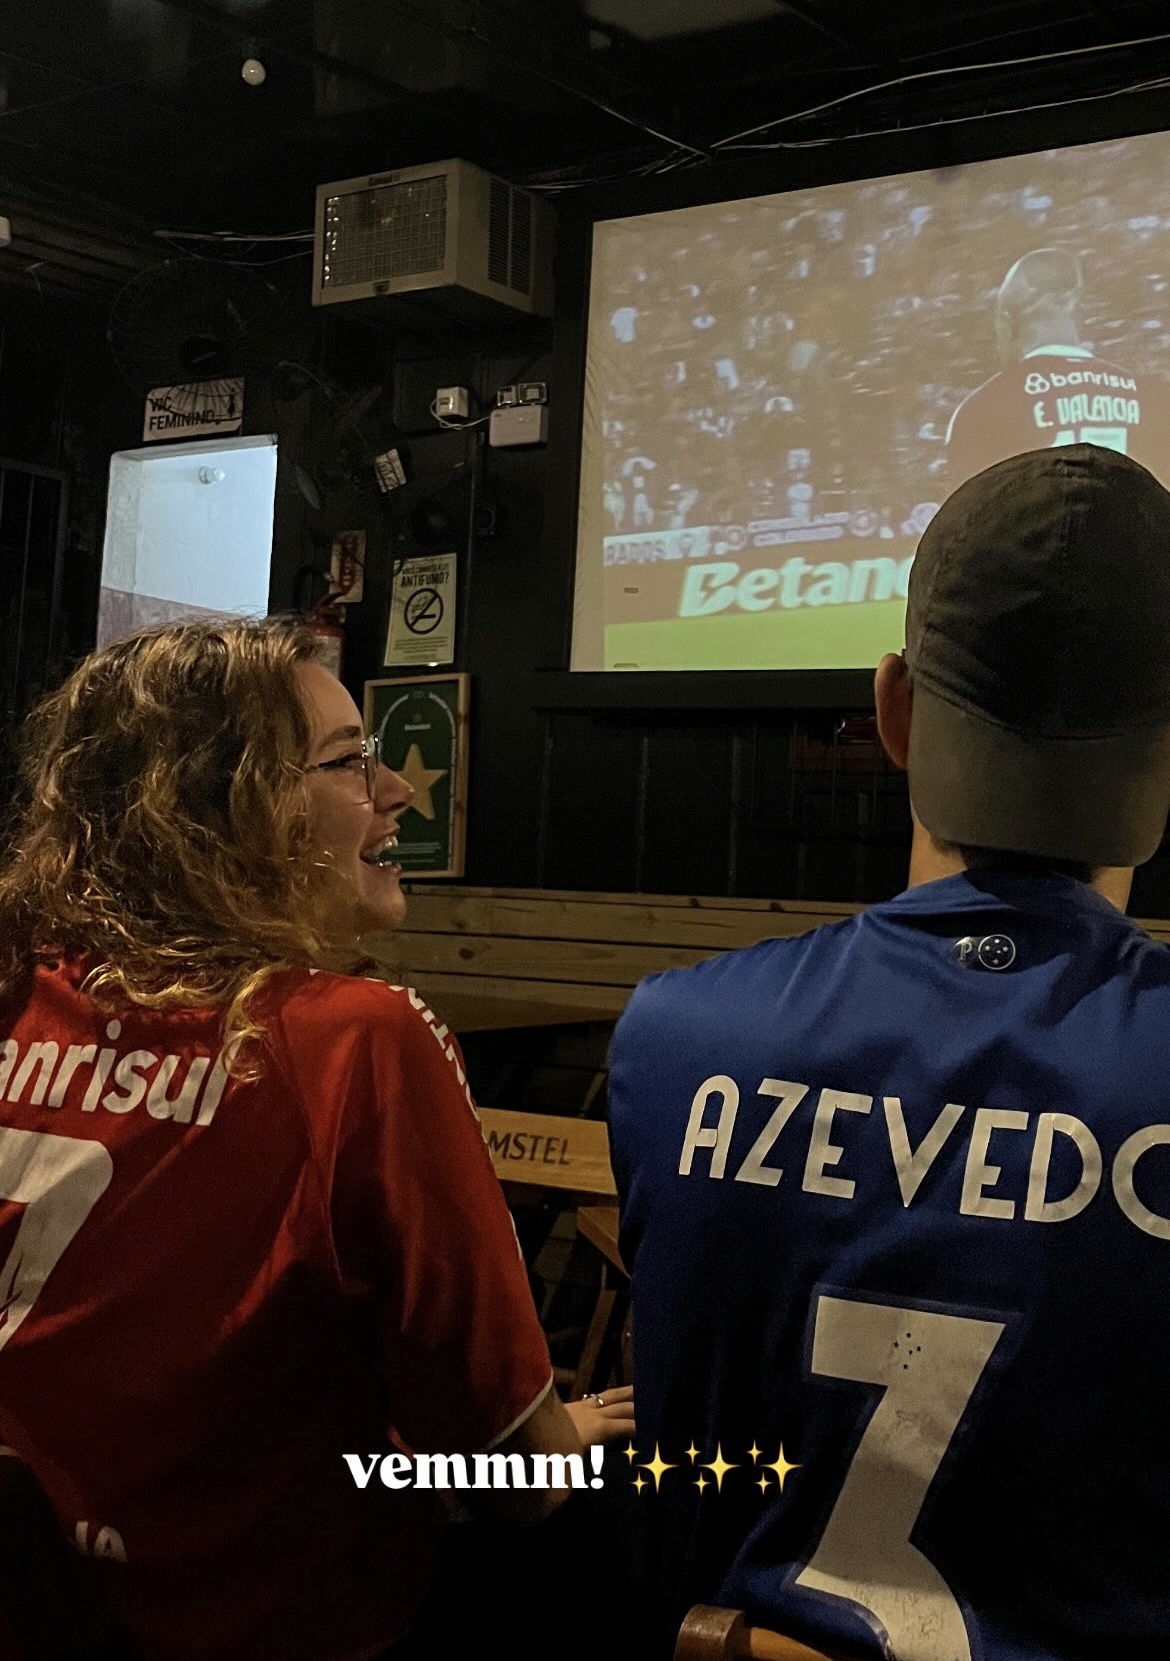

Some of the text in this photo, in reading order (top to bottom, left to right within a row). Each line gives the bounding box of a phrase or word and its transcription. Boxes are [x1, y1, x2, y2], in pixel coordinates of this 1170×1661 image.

[1050, 371, 1137, 392] banrisul
[150, 410, 216, 431] FEMININO
[401, 572, 450, 588] ANTIFUMO?
